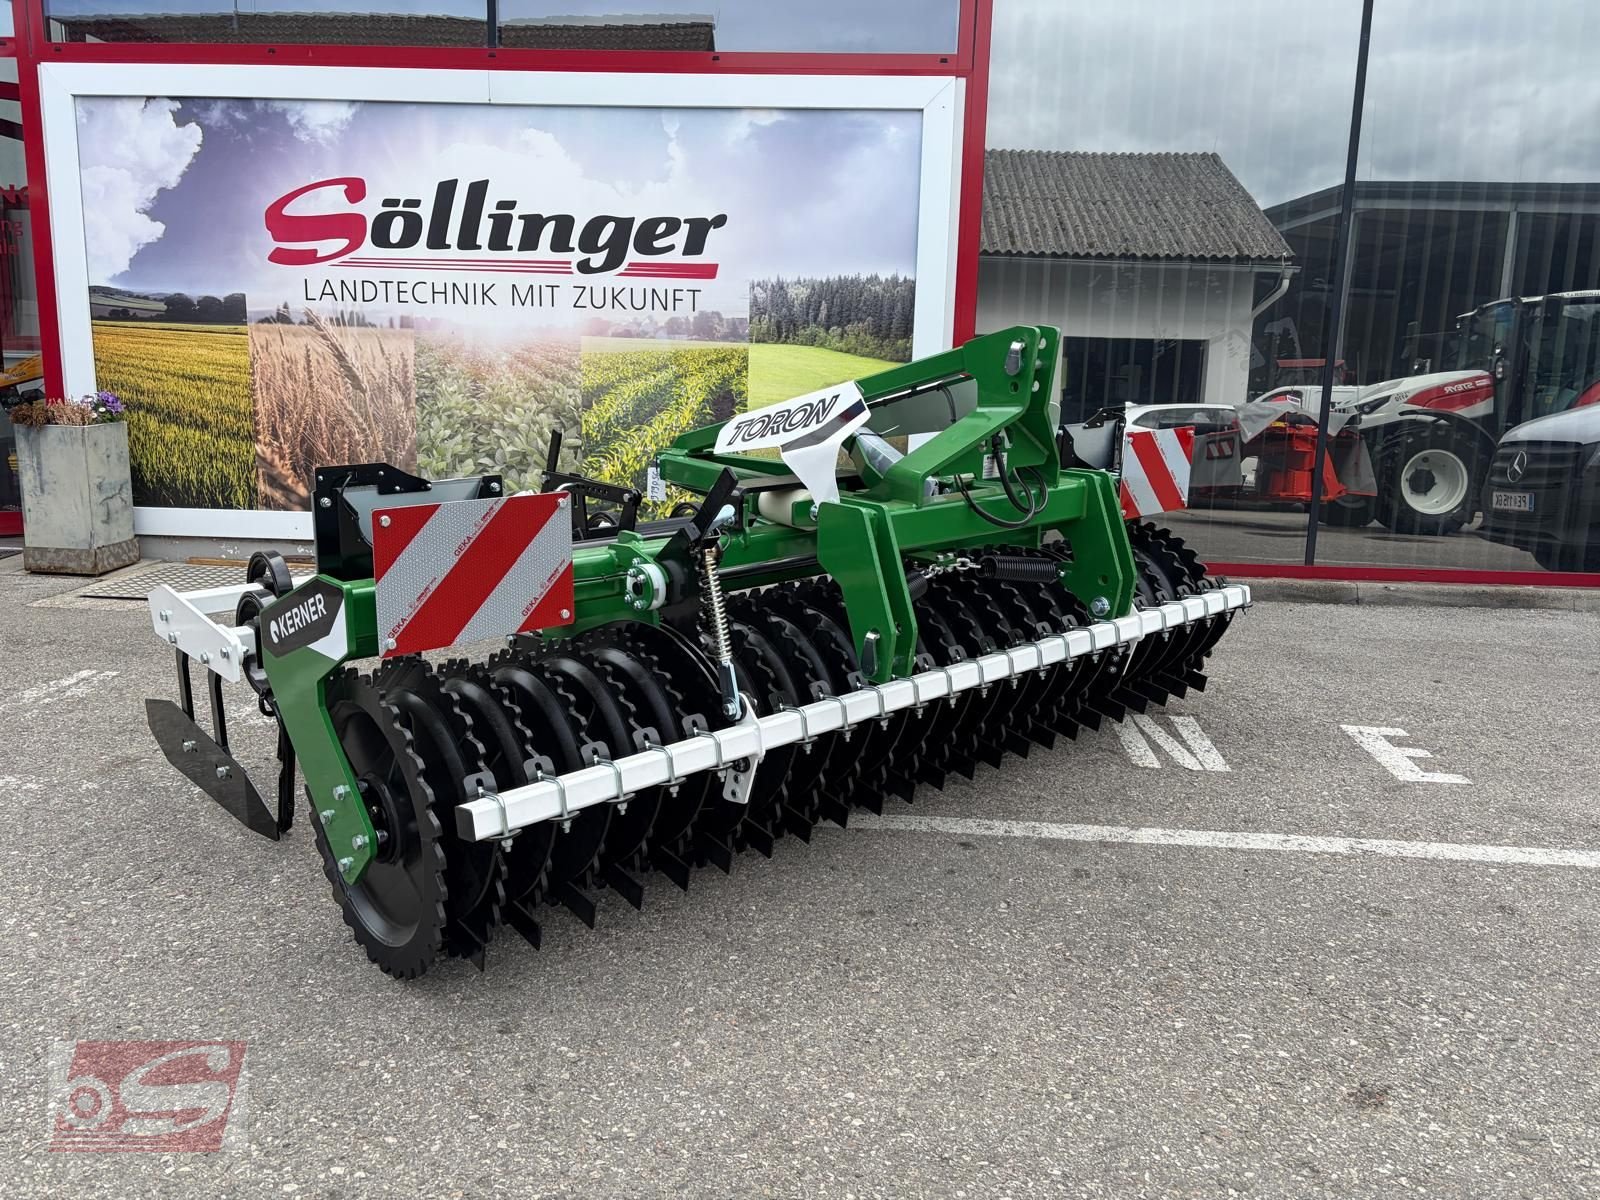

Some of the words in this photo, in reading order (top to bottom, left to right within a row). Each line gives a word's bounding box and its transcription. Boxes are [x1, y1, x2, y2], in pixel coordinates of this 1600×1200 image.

[264, 176, 728, 275] Söllinger
[303, 278, 497, 307] LANDTECHNIK
[511, 283, 561, 309] MIT
[573, 285, 703, 313] ZUKUNFT
[726, 394, 841, 447] TORON
[453, 535, 475, 557] GEKA
[277, 593, 327, 638] KERNER
[521, 596, 540, 617] GEKA
[387, 617, 408, 639] GEKA
